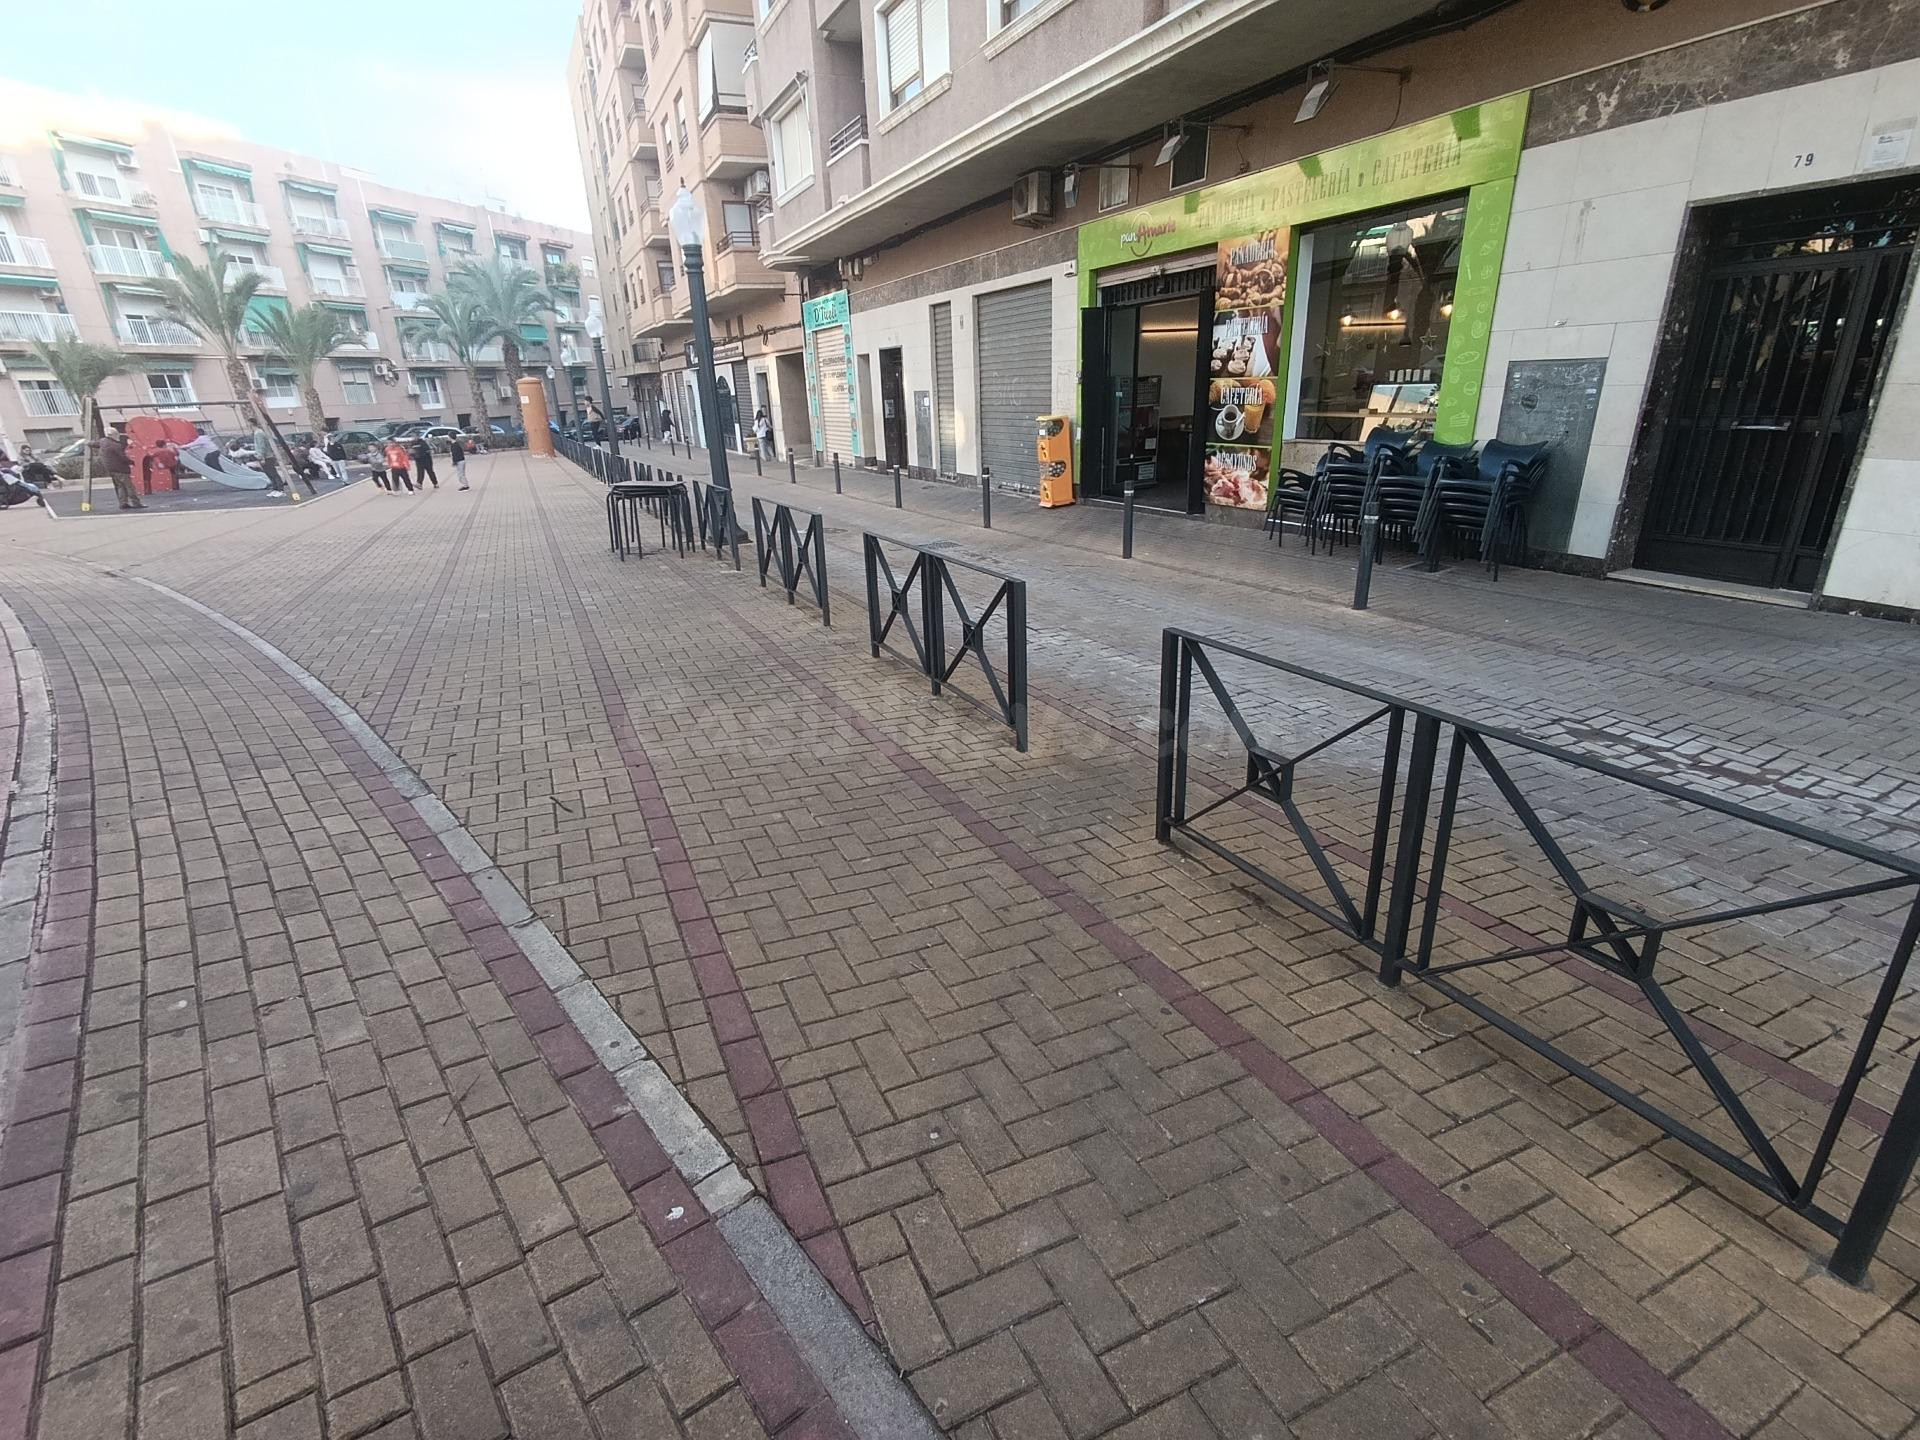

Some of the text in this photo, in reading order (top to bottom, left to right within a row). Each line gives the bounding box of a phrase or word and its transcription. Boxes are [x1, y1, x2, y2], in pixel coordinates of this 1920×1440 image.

[1793, 152, 1815, 168] 79
[1220, 383, 1262, 405] CAFETERÍA
[1216, 451, 1257, 471] DESAYUNOS
